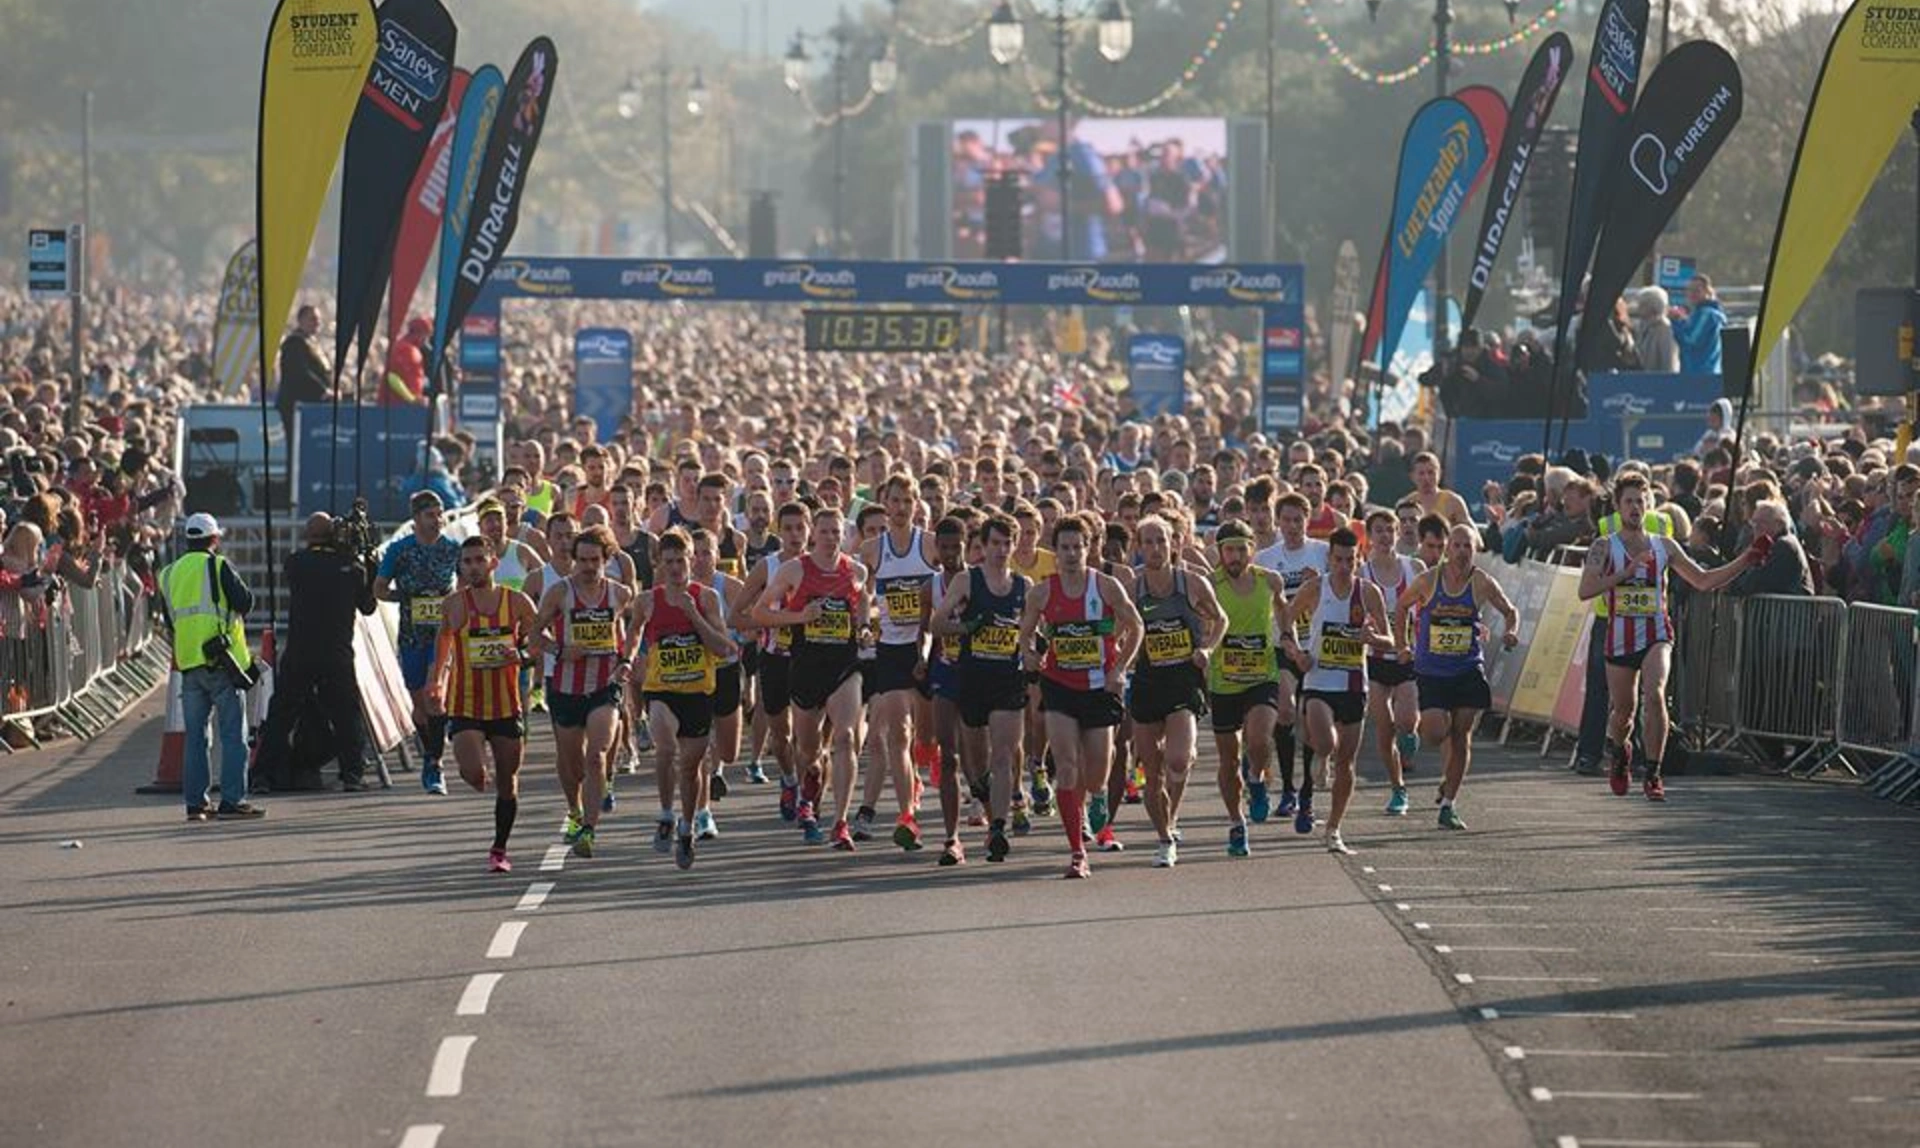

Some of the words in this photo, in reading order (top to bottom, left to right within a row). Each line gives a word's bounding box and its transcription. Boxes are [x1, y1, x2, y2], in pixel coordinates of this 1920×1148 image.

[290, 13, 359, 29] STUDENT
[293, 28, 352, 43] HOUSING
[291, 41, 356, 58] COMPANY
[385, 28, 441, 84] Sanex
[1600, 53, 1625, 96] MEN
[372, 69, 422, 113] MEN
[1673, 84, 1732, 162] PUREGYM
[1397, 136, 1459, 259] Lucozade
[461, 143, 522, 286] DURACELL
[1427, 178, 1466, 240] Sport
[957, 270, 998, 287] south
[1099, 272, 1140, 289] south
[1241, 273, 1283, 289] south
[1438, 633, 1463, 645] 257
[660, 648, 702, 667] SHARP
